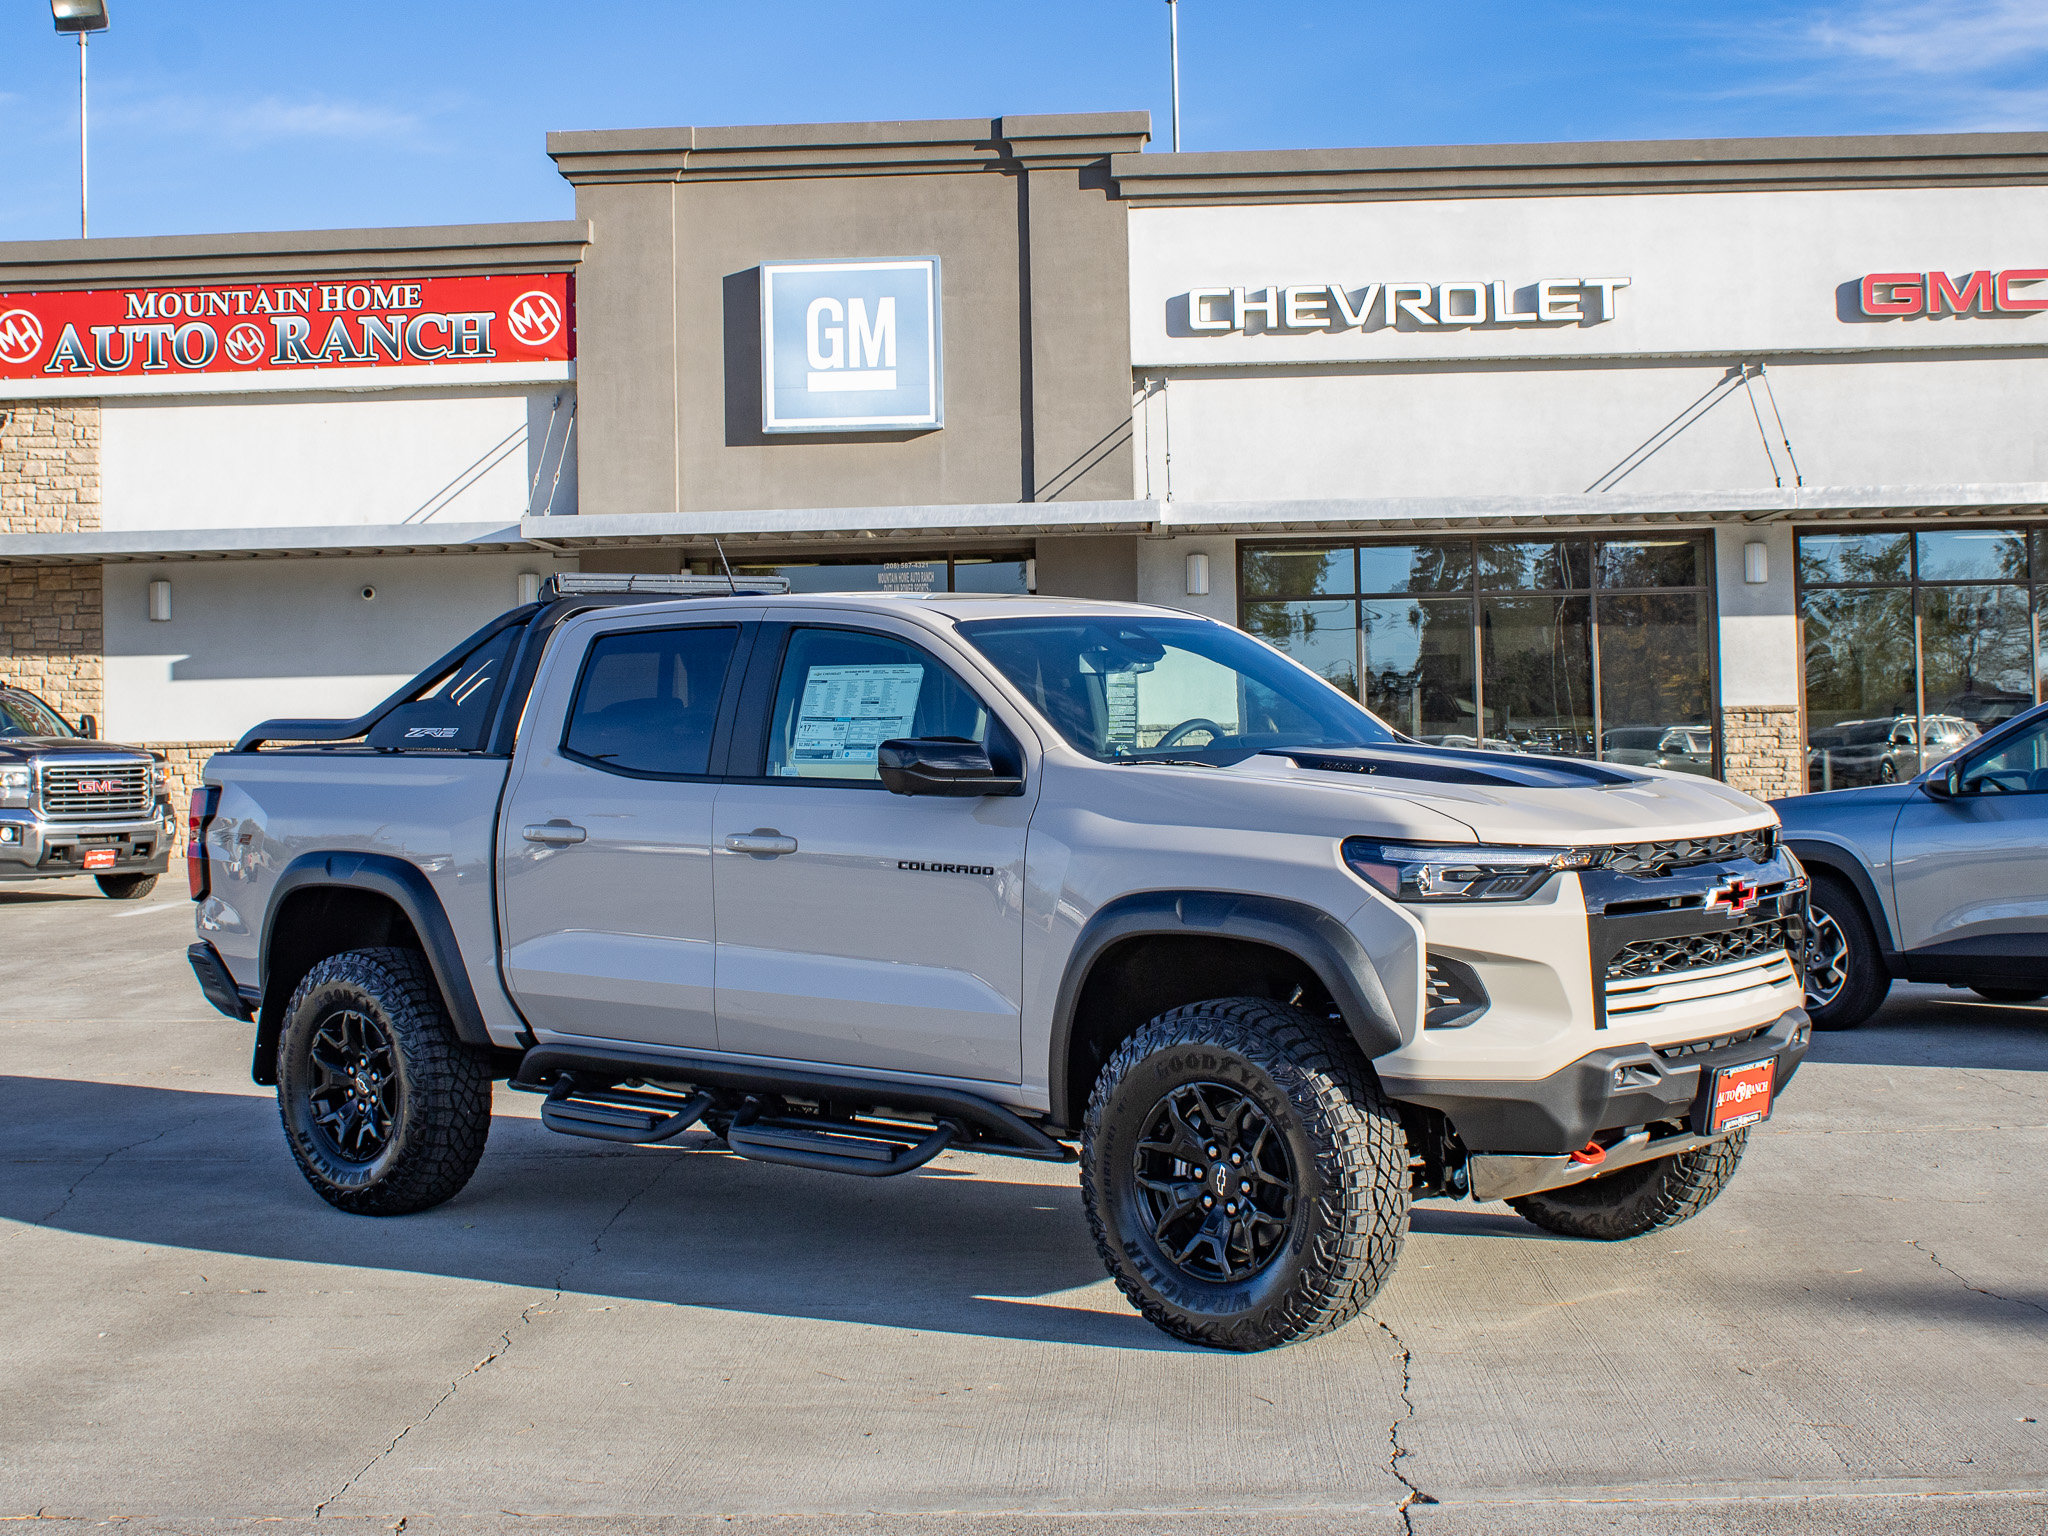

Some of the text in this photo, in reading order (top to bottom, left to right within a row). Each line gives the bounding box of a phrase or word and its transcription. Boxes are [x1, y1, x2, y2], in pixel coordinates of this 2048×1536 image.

[124, 283, 423, 319] MOUNTAIN HOME
[1188, 276, 1632, 330] CHEVROLET
[1860, 268, 2048, 316] GMC
[44, 321, 219, 373] AUTO
[269, 311, 497, 365] RANCH
[806, 296, 897, 371] GM
[877, 571, 935, 584] MOUNTAIN HOME AUTO RANCH
[78, 780, 123, 793] GMC
[897, 860, 995, 876] COLORADO
[1155, 1052, 1294, 1133] GOODYEAR
[1715, 1081, 1769, 1107] AUTO RANCH
[1123, 1239, 1252, 1314] WRANGLER
